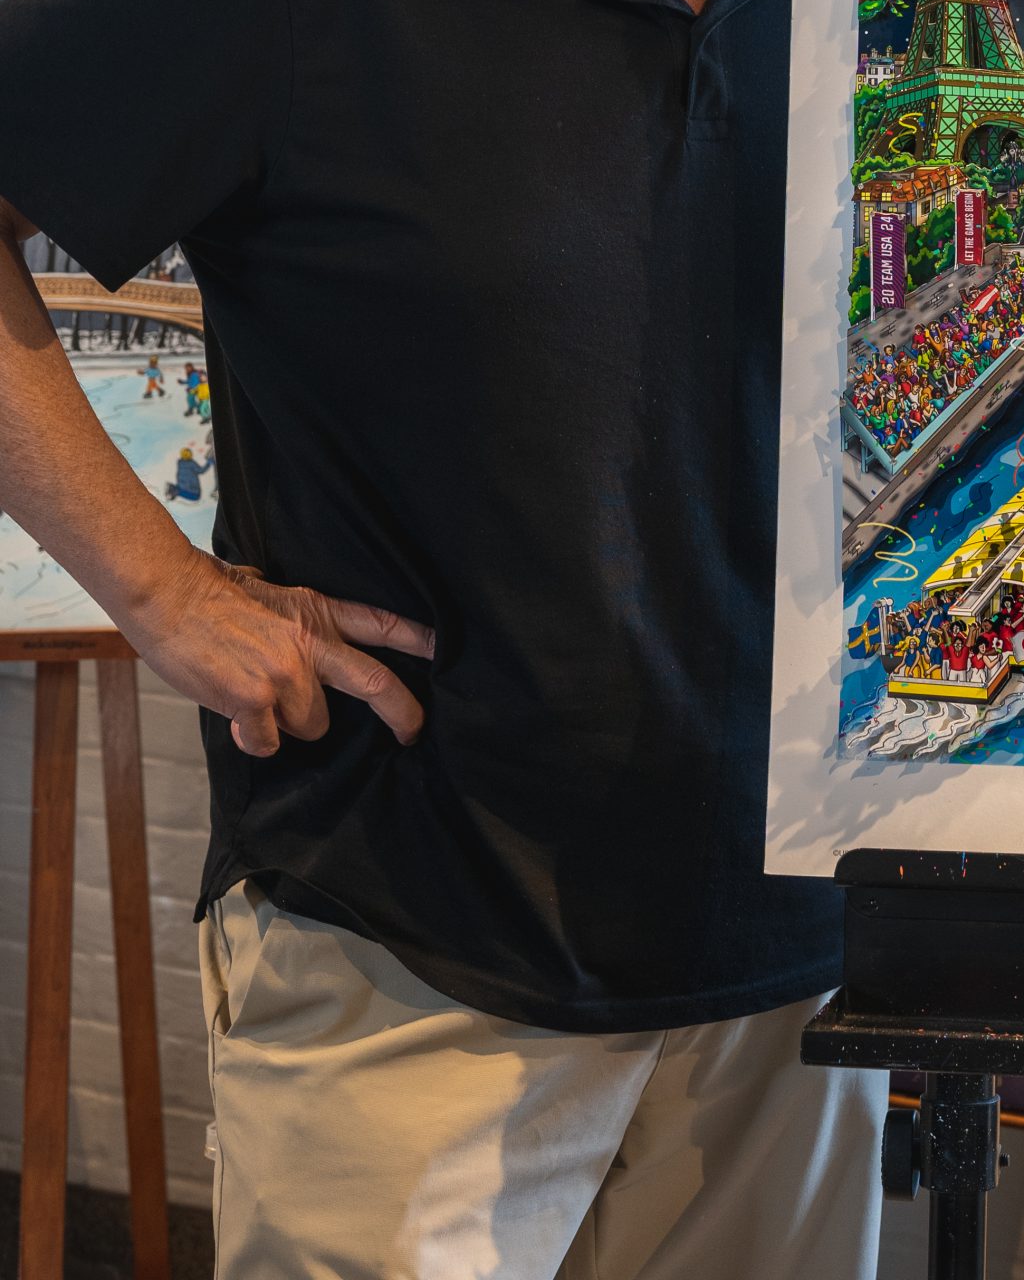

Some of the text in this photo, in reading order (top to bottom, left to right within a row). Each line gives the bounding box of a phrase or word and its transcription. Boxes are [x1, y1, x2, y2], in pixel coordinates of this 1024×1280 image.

[880, 216, 895, 304] 20 TEAM USA 24
[965, 193, 974, 261] LET THE GAMES BEGIN
